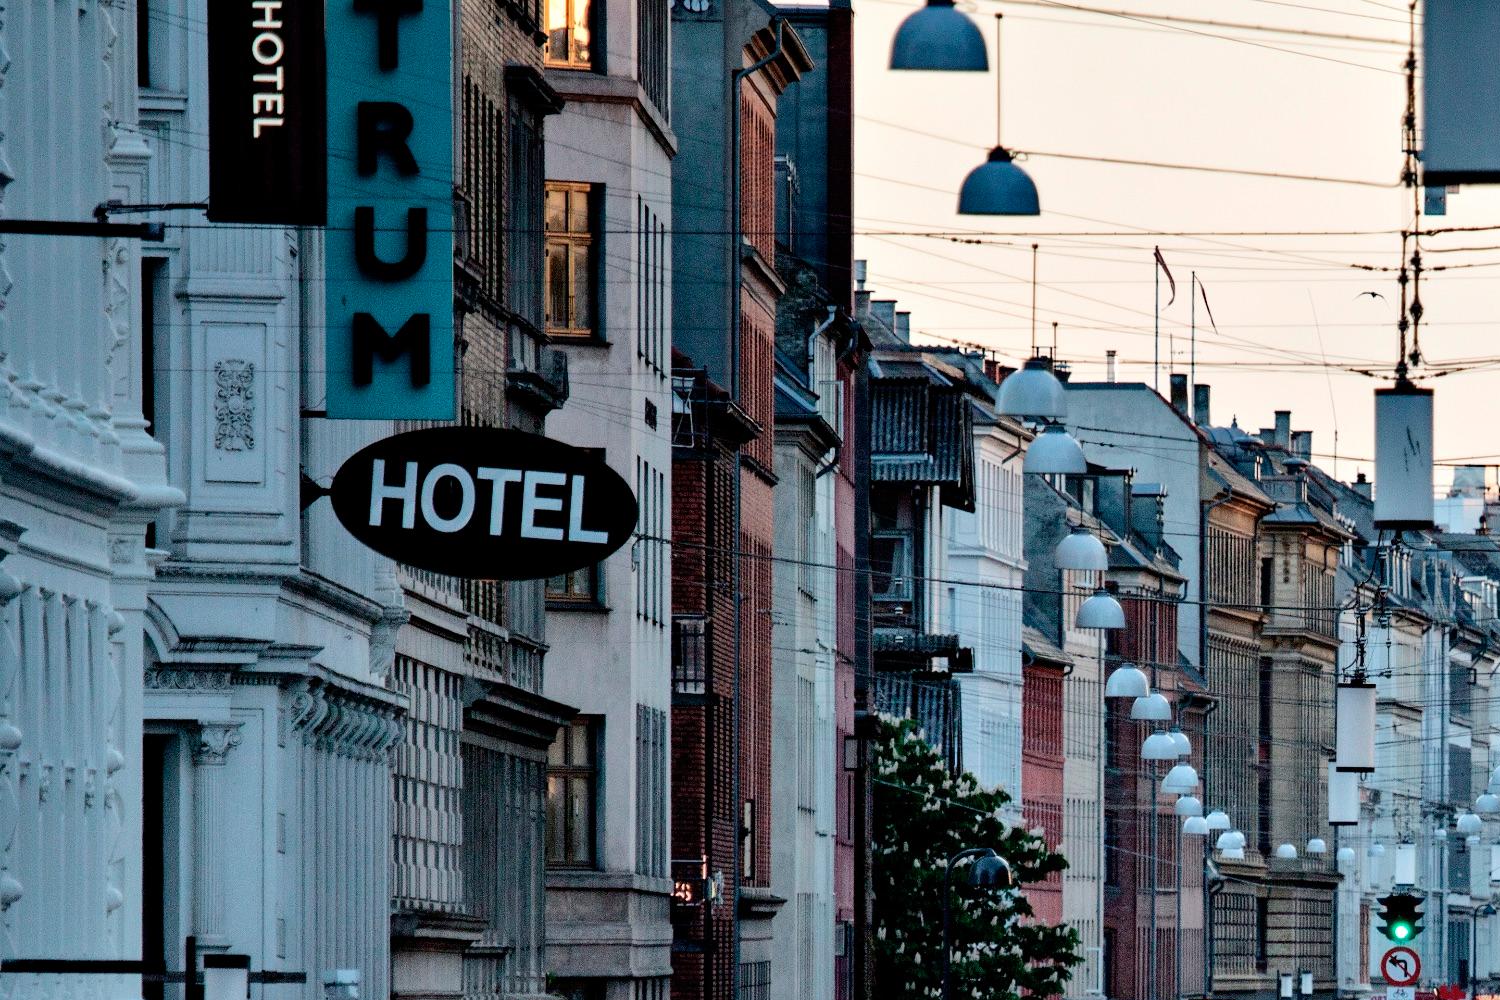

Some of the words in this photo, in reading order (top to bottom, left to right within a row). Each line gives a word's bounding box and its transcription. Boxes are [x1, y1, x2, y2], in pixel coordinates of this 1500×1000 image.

[252, 1, 284, 139] HOTEL
[352, 0, 431, 387] TRUM
[368, 458, 609, 544] HOTEL
